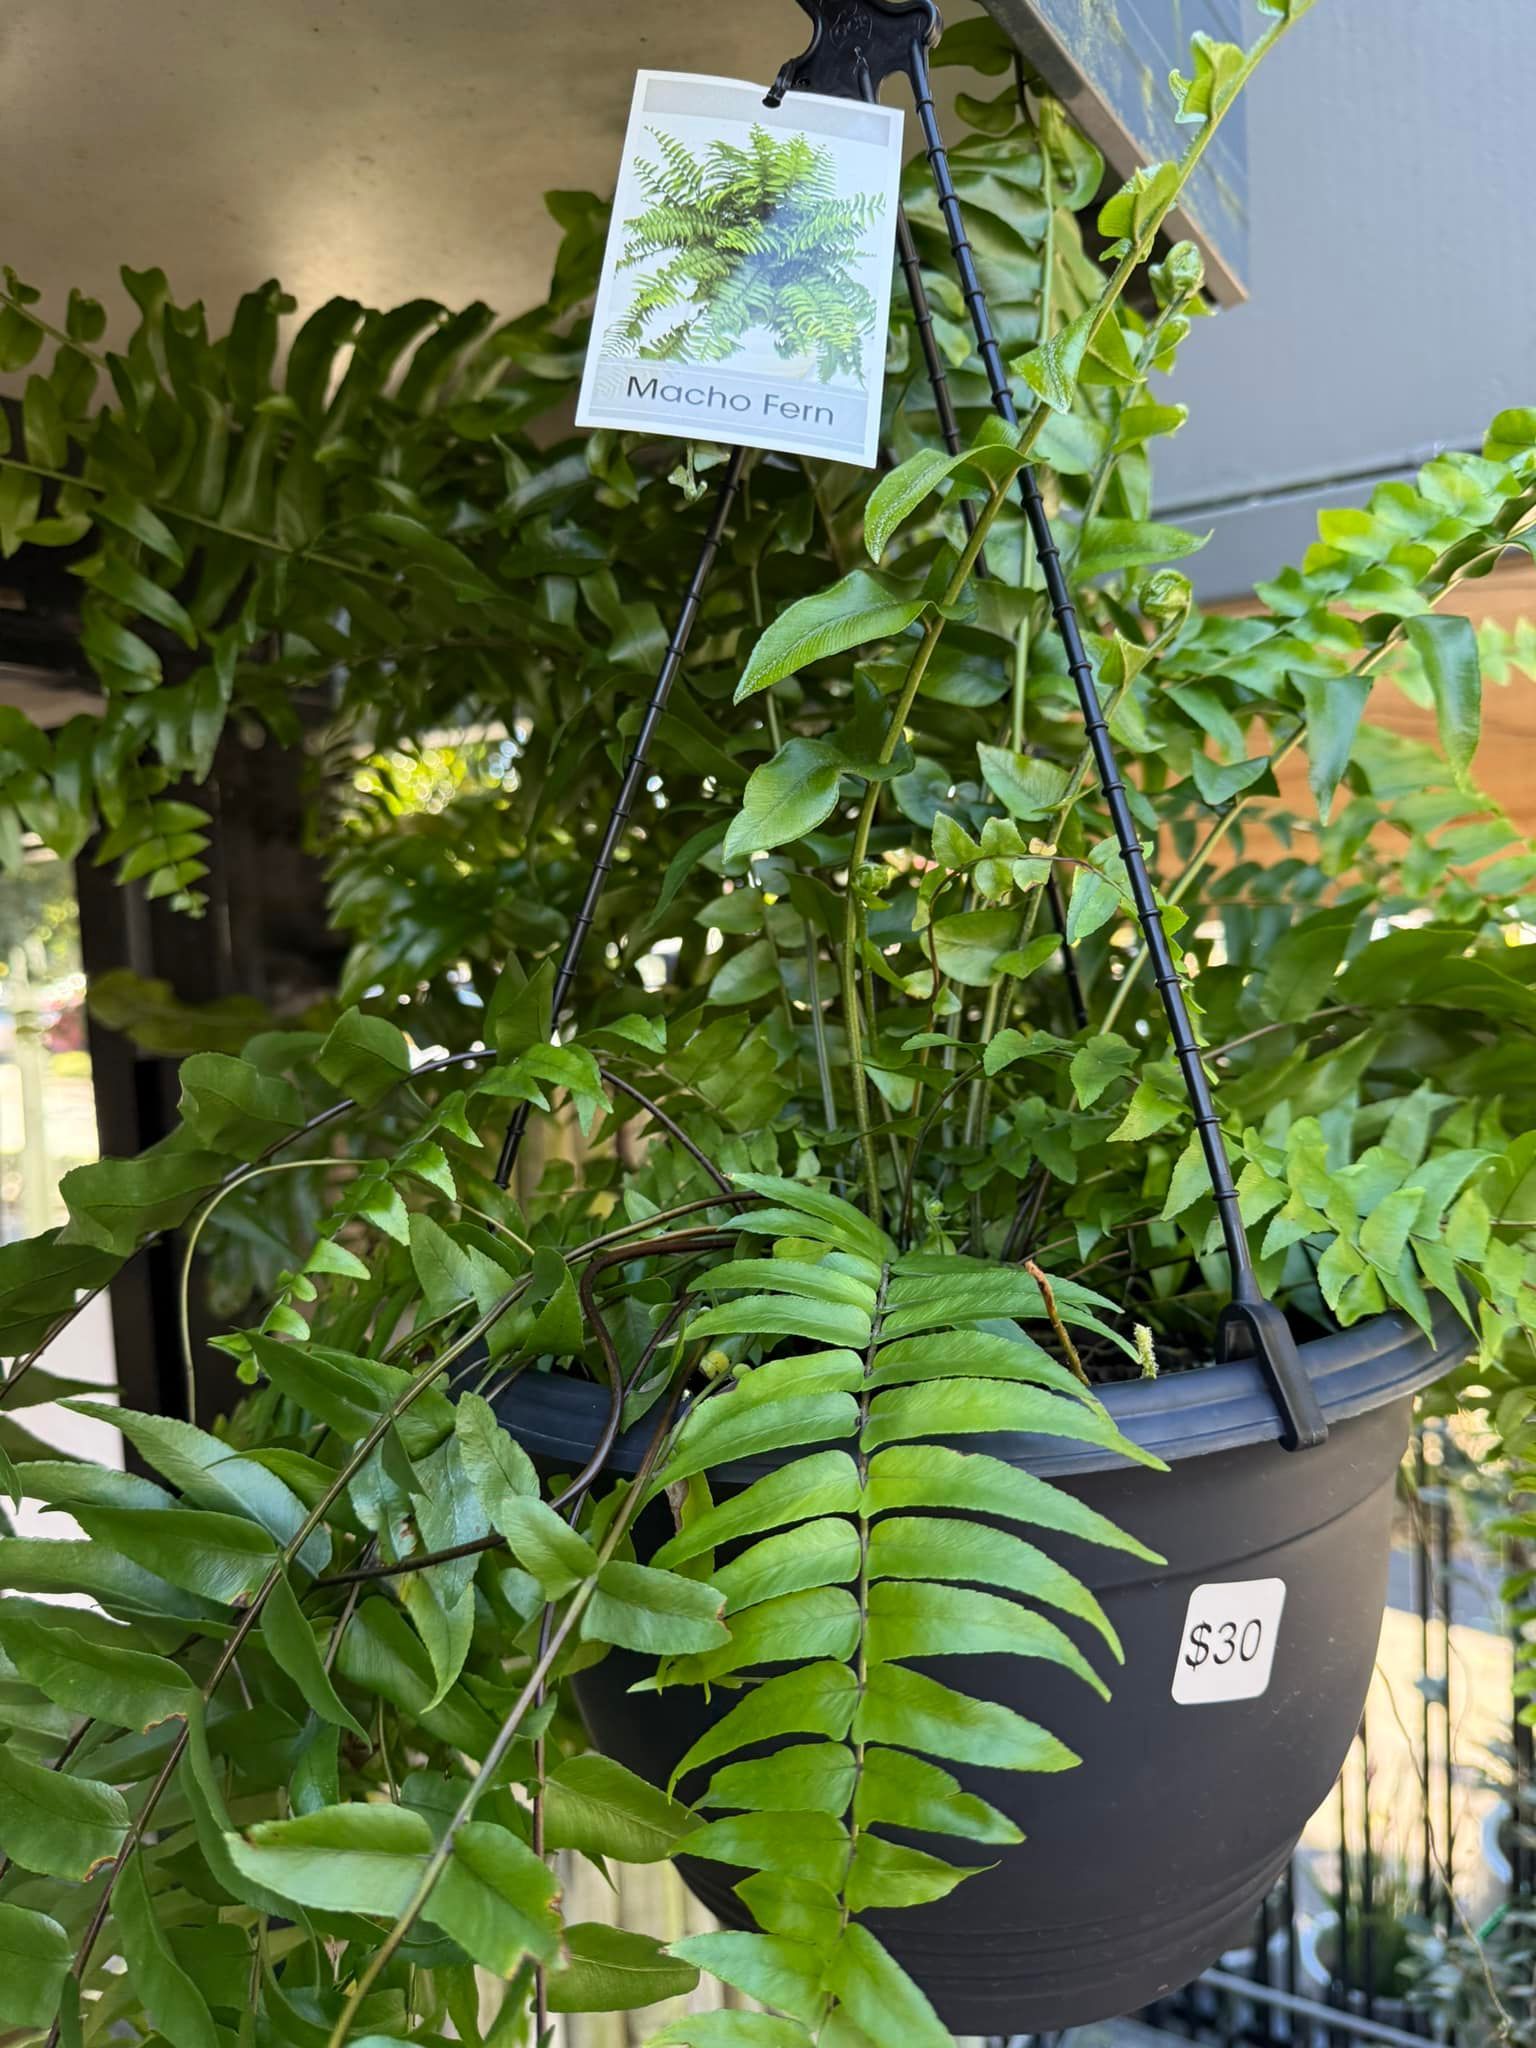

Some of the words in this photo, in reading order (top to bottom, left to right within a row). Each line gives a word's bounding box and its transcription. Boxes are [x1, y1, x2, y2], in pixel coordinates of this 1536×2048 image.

[626, 376, 751, 412] Macho
[763, 394, 834, 425] Fern
[1185, 1618, 1262, 1671] $30
